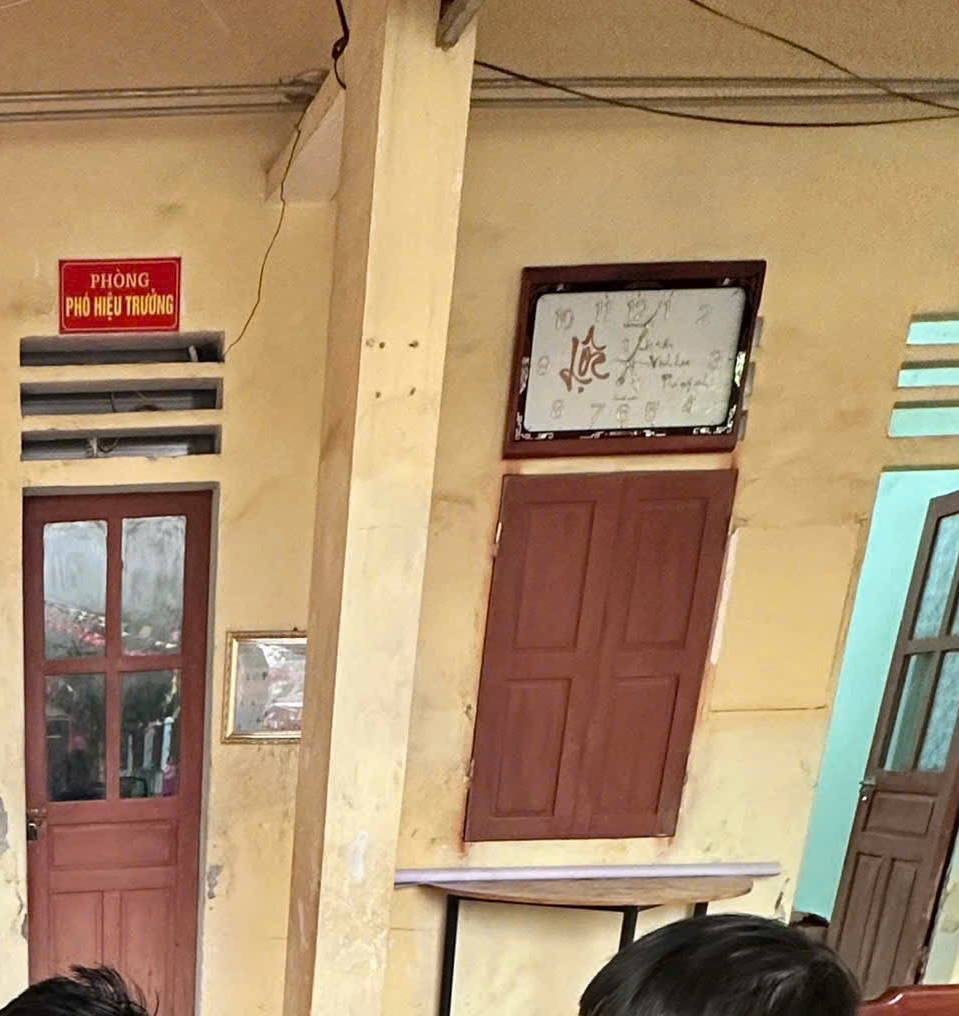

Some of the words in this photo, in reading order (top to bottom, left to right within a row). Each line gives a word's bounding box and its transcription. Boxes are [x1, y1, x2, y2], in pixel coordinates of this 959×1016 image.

[90, 268, 150, 289] PHÒNG
[65, 292, 90, 317] PHÓ
[94, 291, 122, 321] HIỆU
[125, 288, 174, 317] TRƯỞNG
